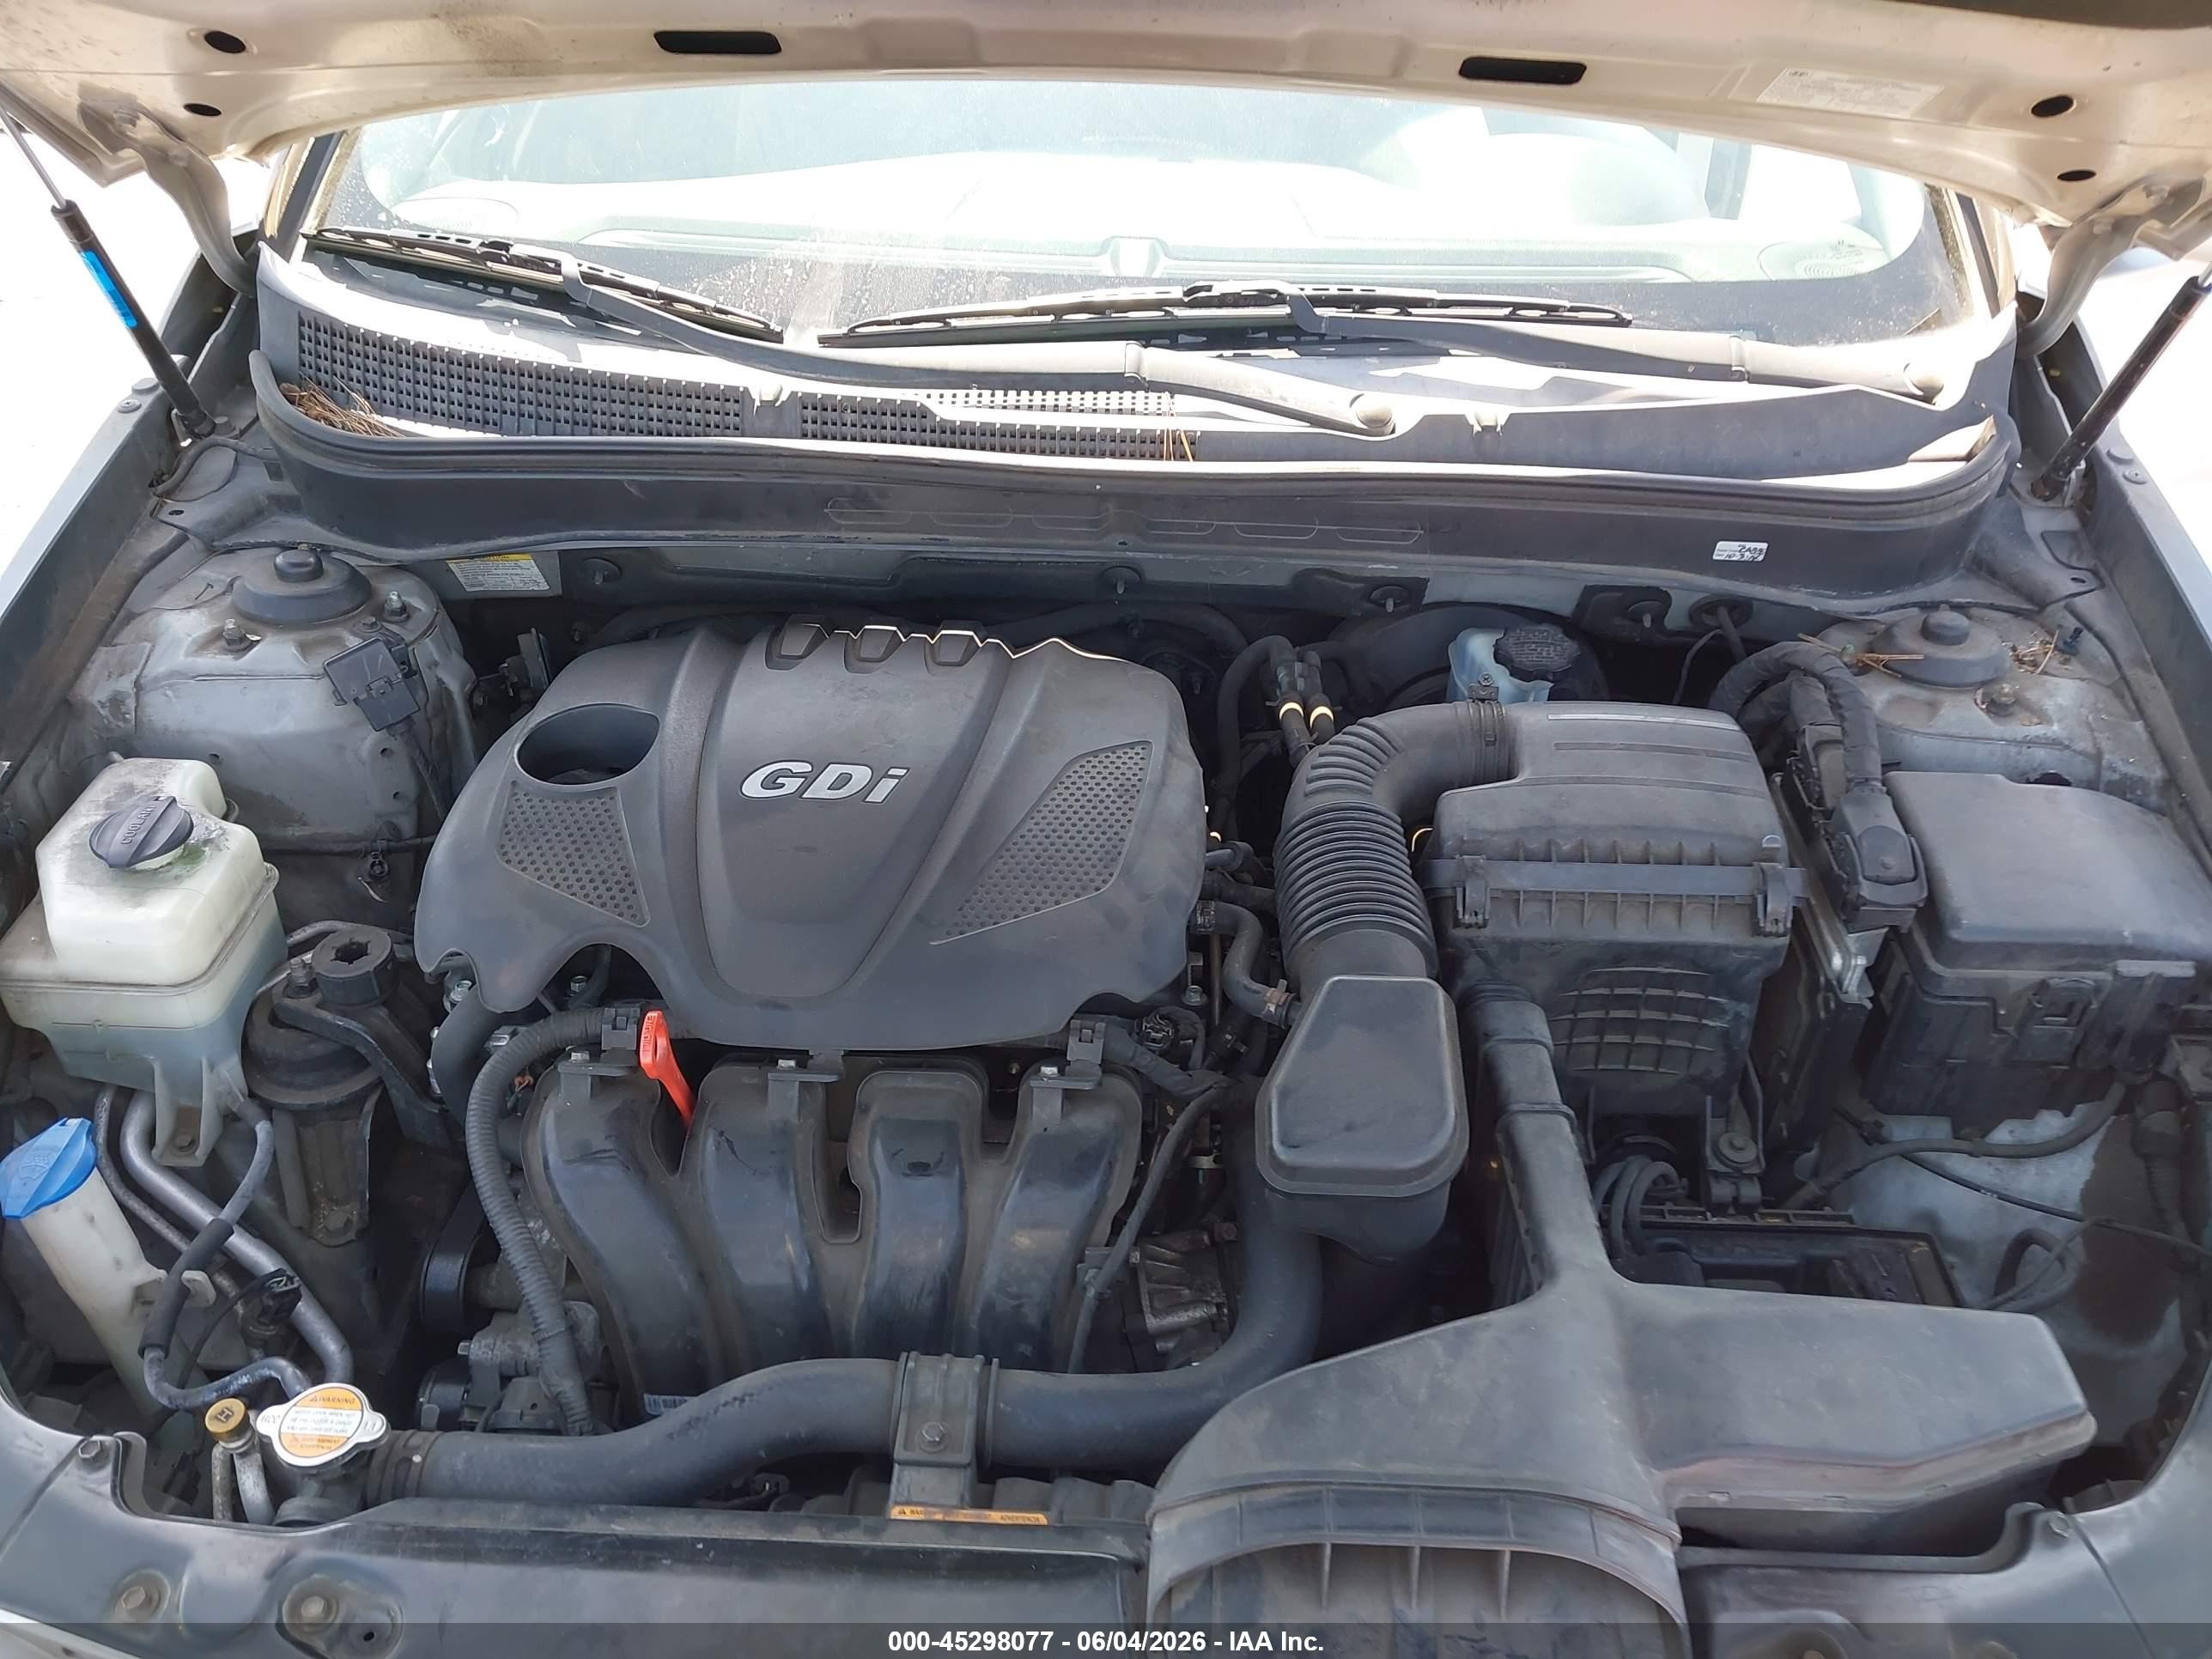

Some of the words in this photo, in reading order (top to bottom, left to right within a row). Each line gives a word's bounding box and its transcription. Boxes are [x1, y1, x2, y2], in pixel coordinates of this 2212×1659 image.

[740, 759, 910, 804] GDi
[319, 1395, 356, 1405] WARNING
[216, 1407, 234, 1422] H
